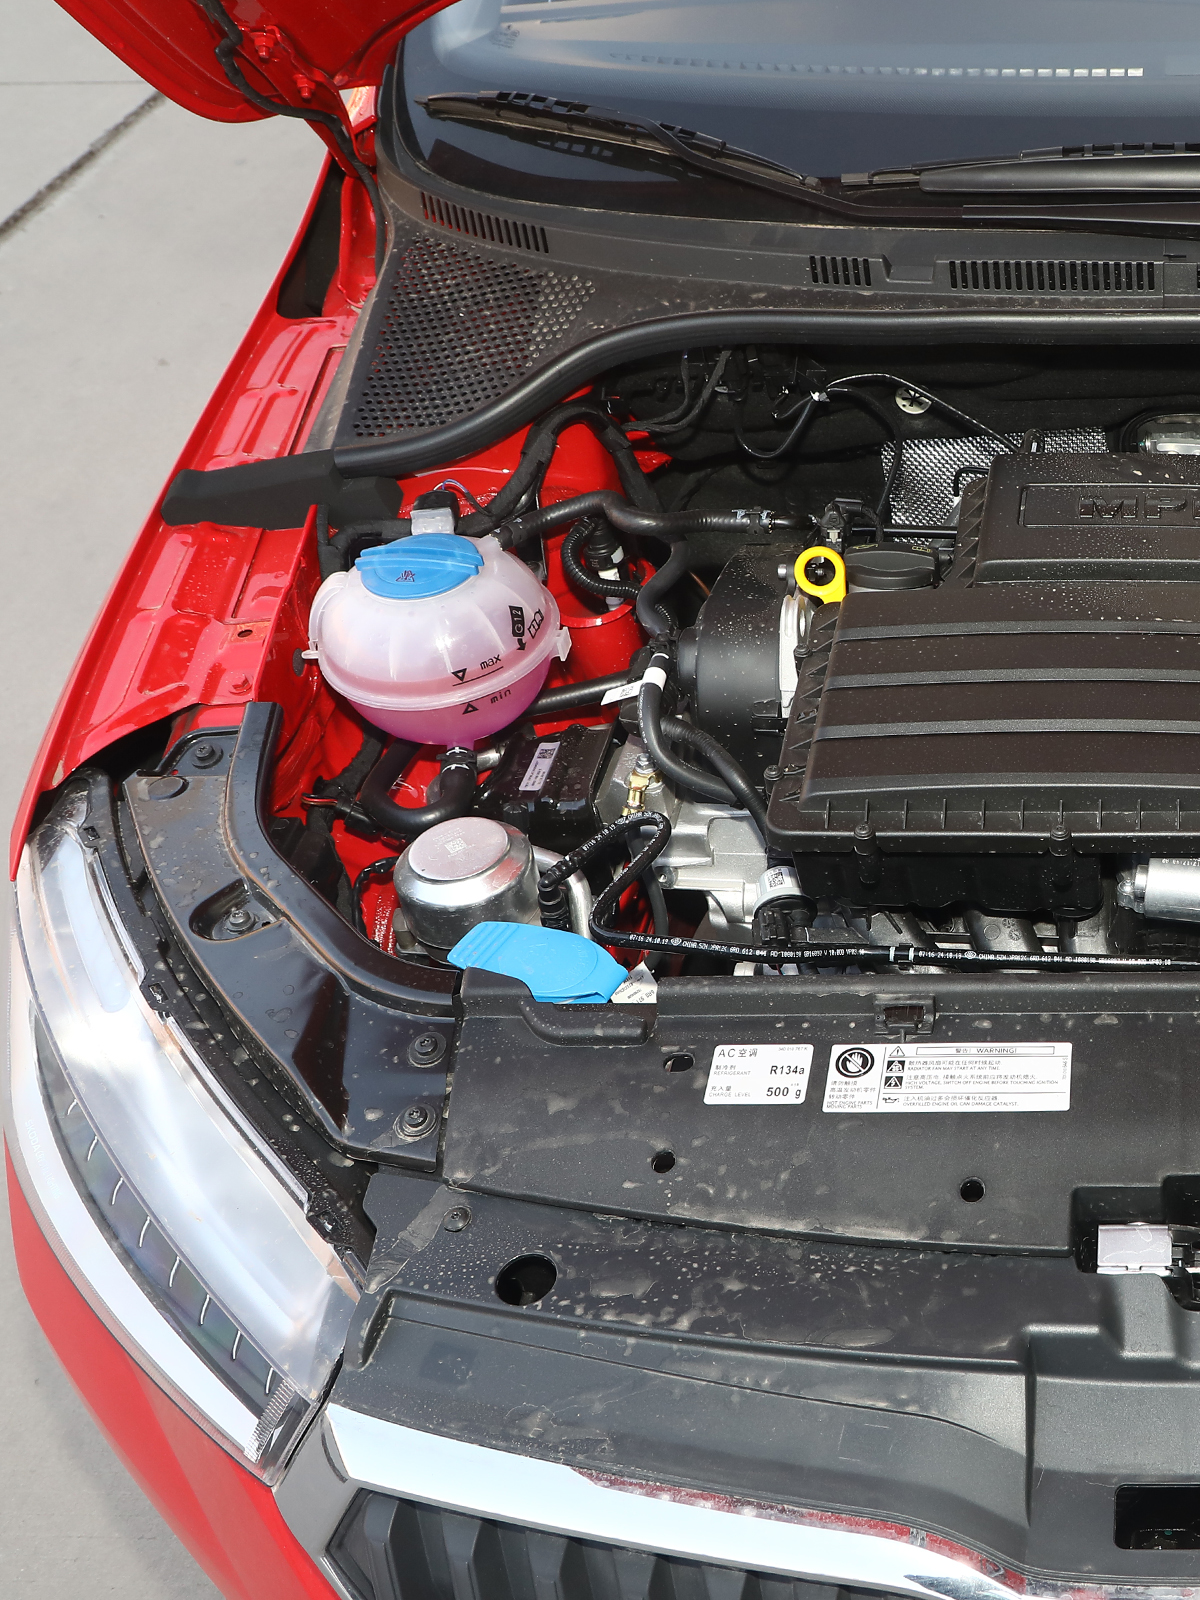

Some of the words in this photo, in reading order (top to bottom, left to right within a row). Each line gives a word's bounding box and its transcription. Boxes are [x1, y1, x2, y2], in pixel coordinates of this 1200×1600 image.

[512, 609, 524, 634] G12
[480, 654, 502, 670] max
[490, 689, 511, 704] min
[629, 934, 645, 942] 07:16
[645, 937, 669, 945] 24.10.19
[682, 940, 697, 949] CHINA
[918, 950, 935, 958] 07:16
[769, 1065, 805, 1075] R134a
[766, 1086, 790, 1097] 500
[794, 1089, 802, 1099] g
